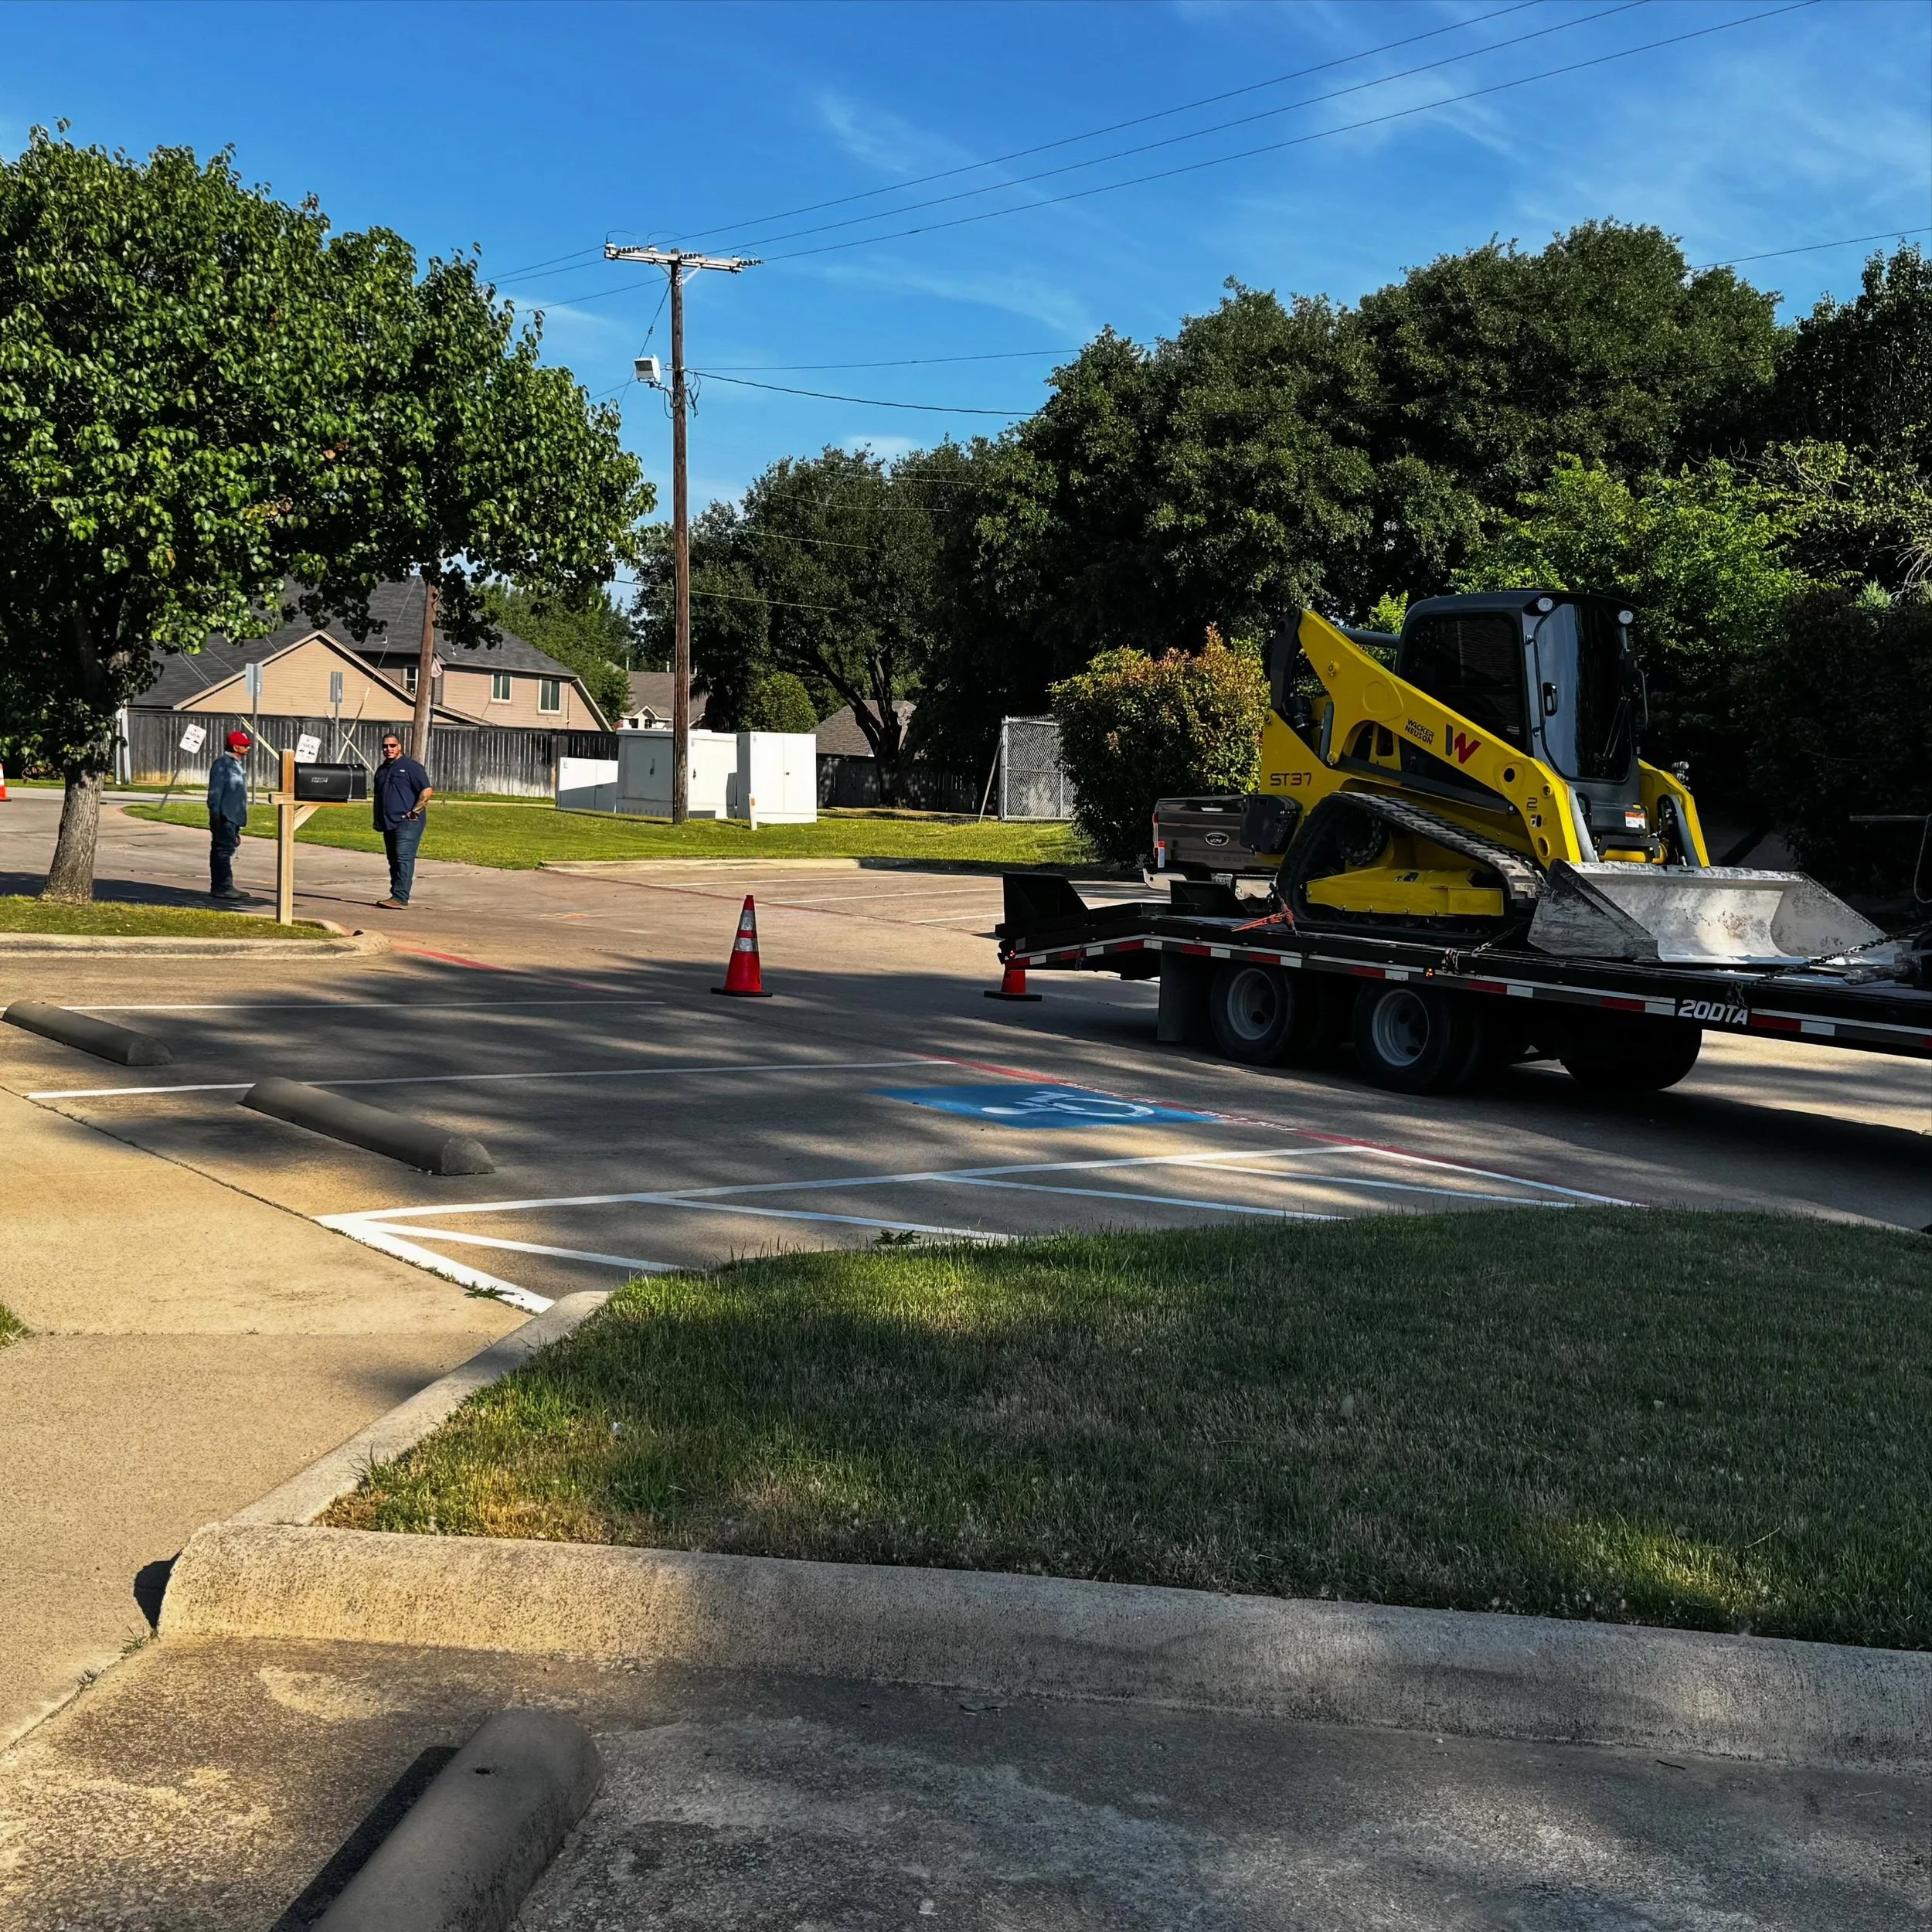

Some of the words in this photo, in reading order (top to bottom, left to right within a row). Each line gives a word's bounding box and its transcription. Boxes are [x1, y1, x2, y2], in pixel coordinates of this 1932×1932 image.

[1270, 772, 1311, 787] ST37
[1526, 797, 1538, 809] 2
[1678, 999, 1748, 1026] 20DTA
